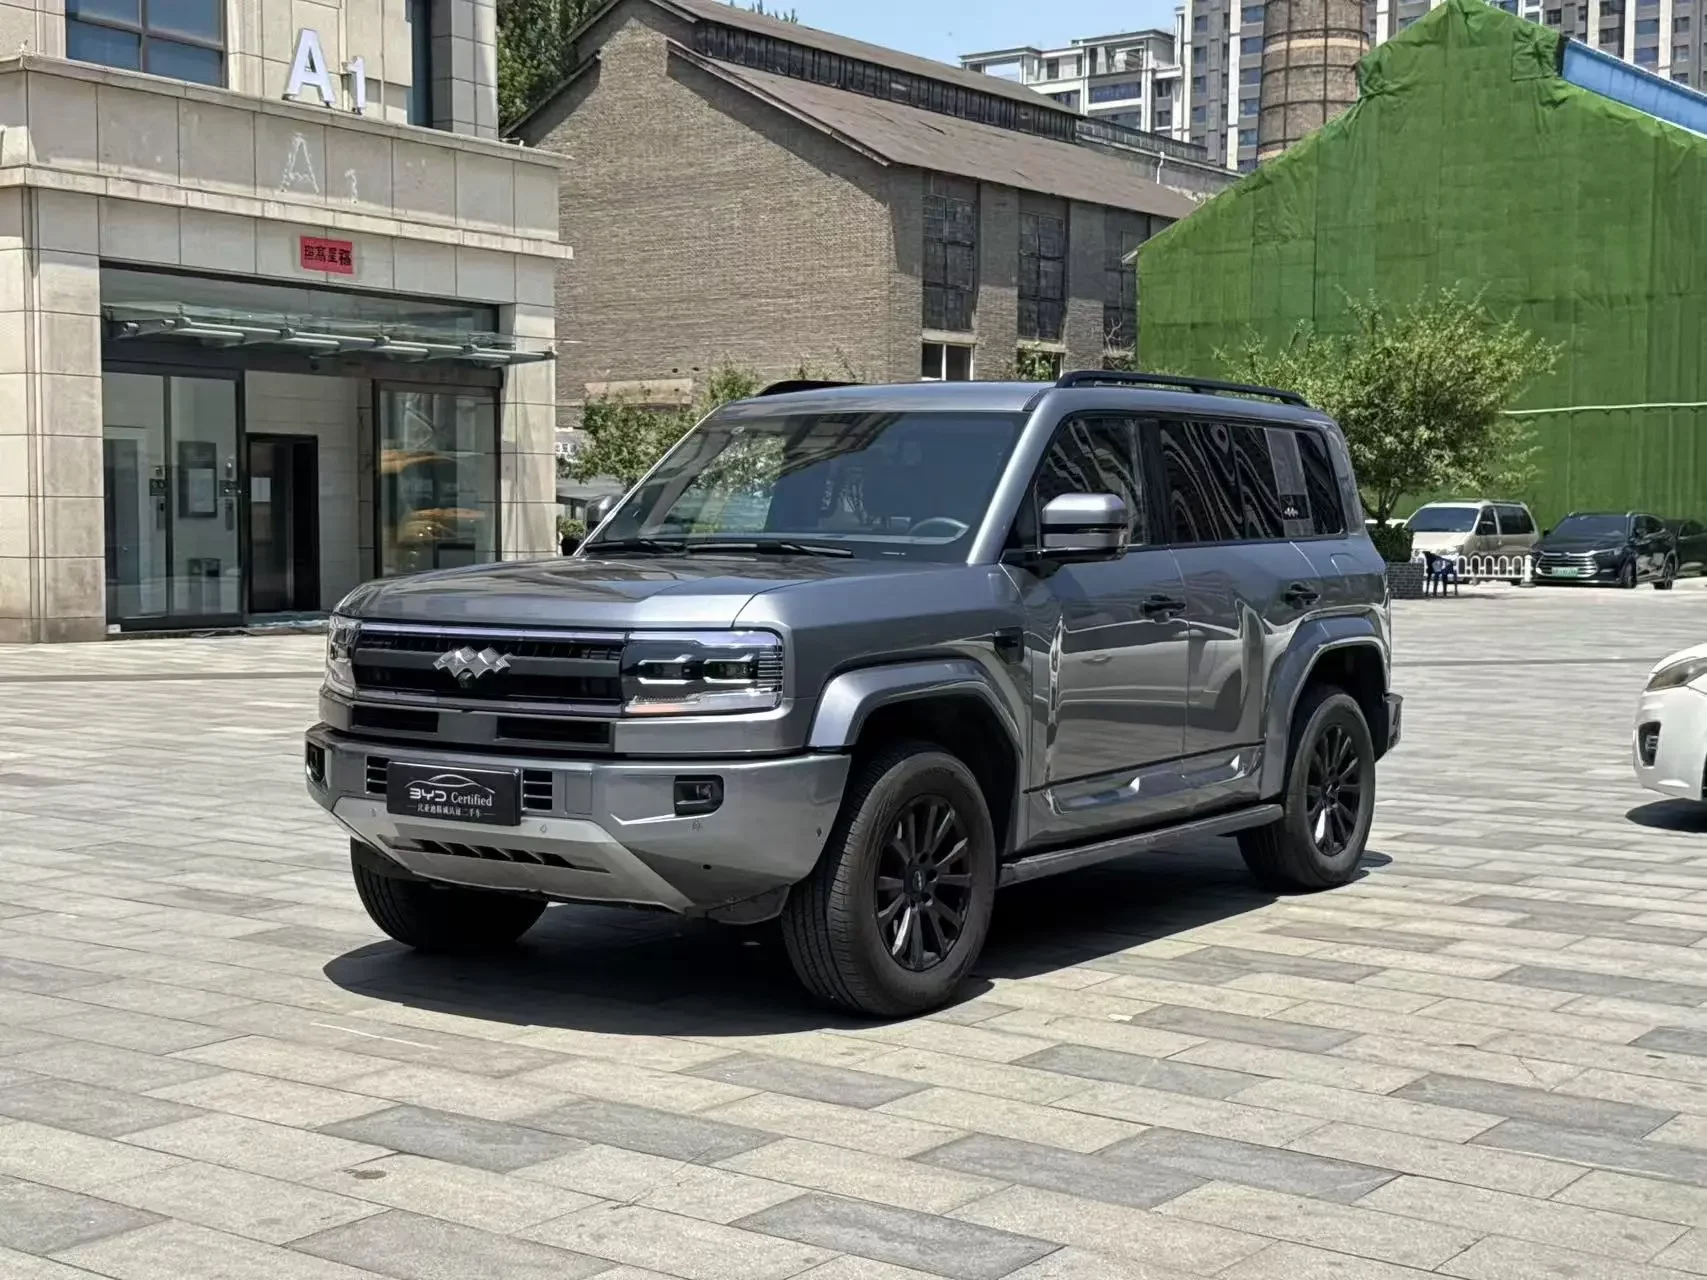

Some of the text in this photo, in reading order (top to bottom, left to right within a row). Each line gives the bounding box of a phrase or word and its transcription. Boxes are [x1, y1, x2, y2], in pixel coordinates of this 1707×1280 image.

[283, 28, 366, 110] A1
[409, 787, 493, 807] BYD Certified
